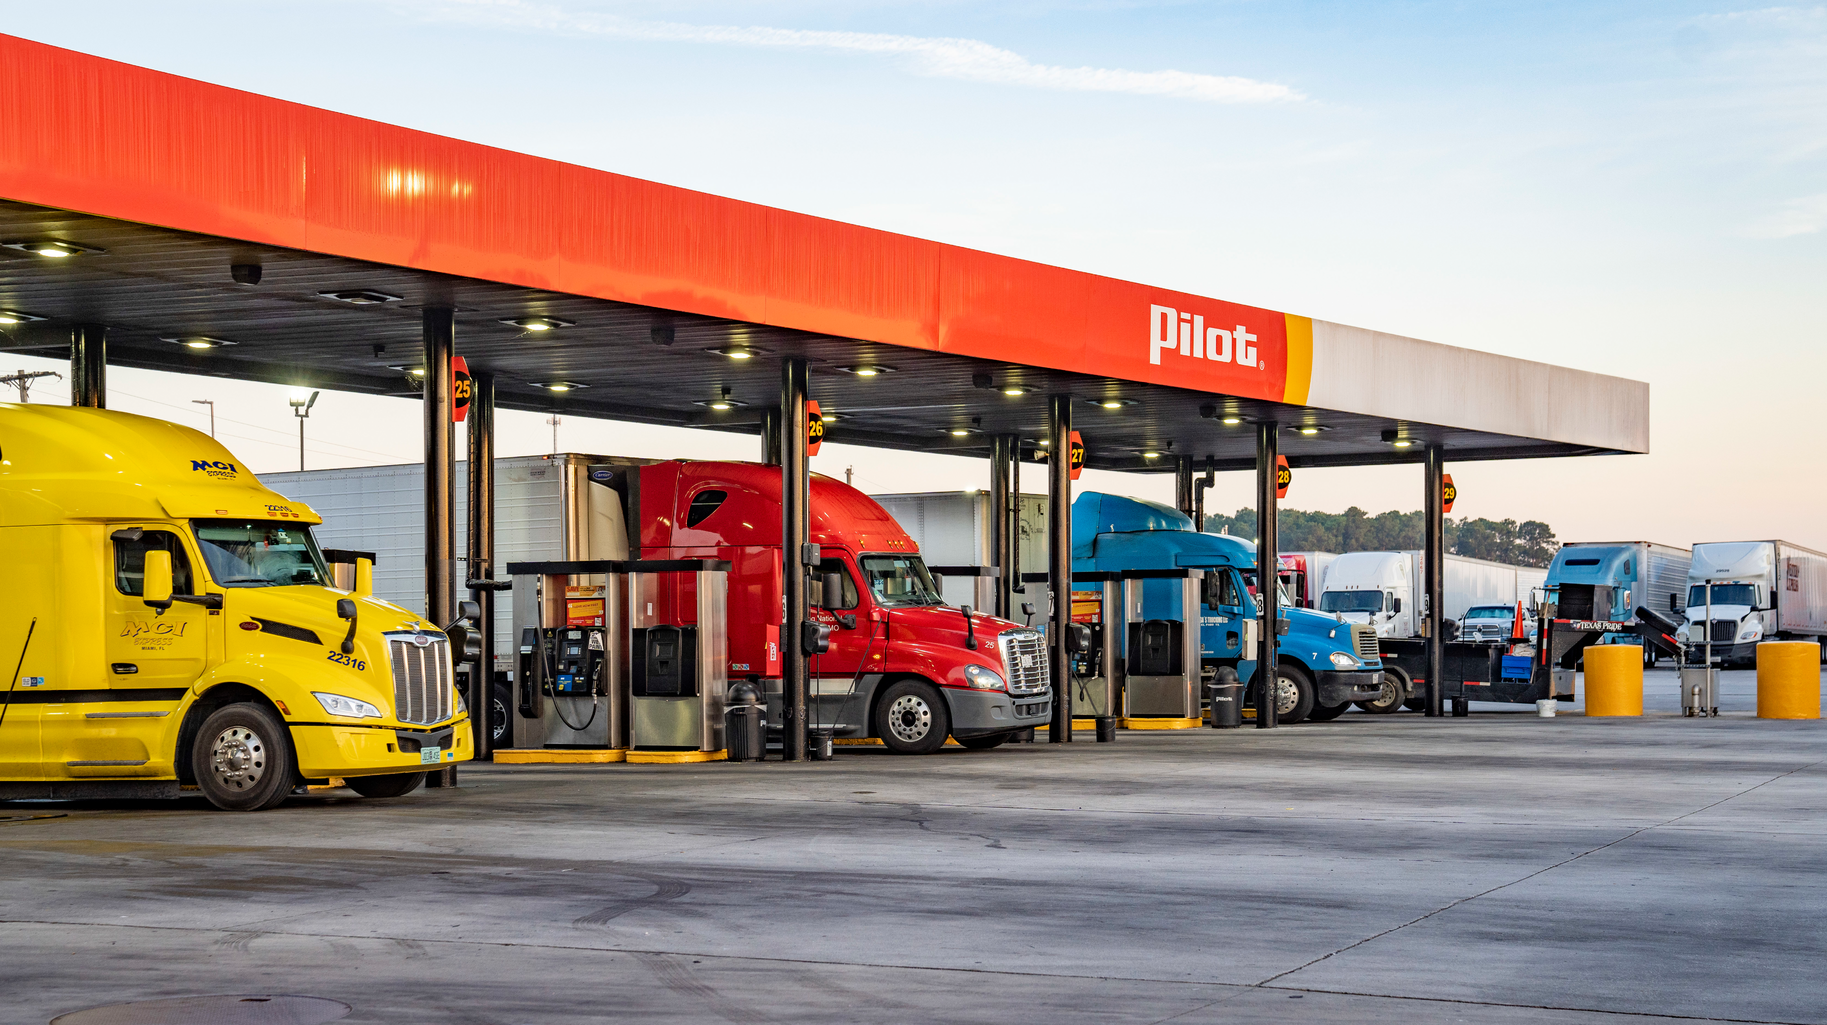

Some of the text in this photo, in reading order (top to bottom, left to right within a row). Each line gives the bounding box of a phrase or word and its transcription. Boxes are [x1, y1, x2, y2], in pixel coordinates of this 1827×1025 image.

[1149, 303, 1258, 368] Pilot
[455, 380, 471, 398] 25
[809, 420, 823, 437] 26
[1071, 448, 1084, 463] 27
[190, 459, 239, 475] MCI
[1278, 470, 1290, 484] 28
[1444, 487, 1455, 499] 29
[817, 614, 843, 623] Nationl
[120, 620, 188, 637] MCI
[1581, 621, 1623, 631] TEXAS PRIDE
[133, 637, 174, 646] EXPRESS
[984, 640, 995, 649] 25
[326, 650, 367, 671] 22316
[1312, 652, 1318, 660] 7
